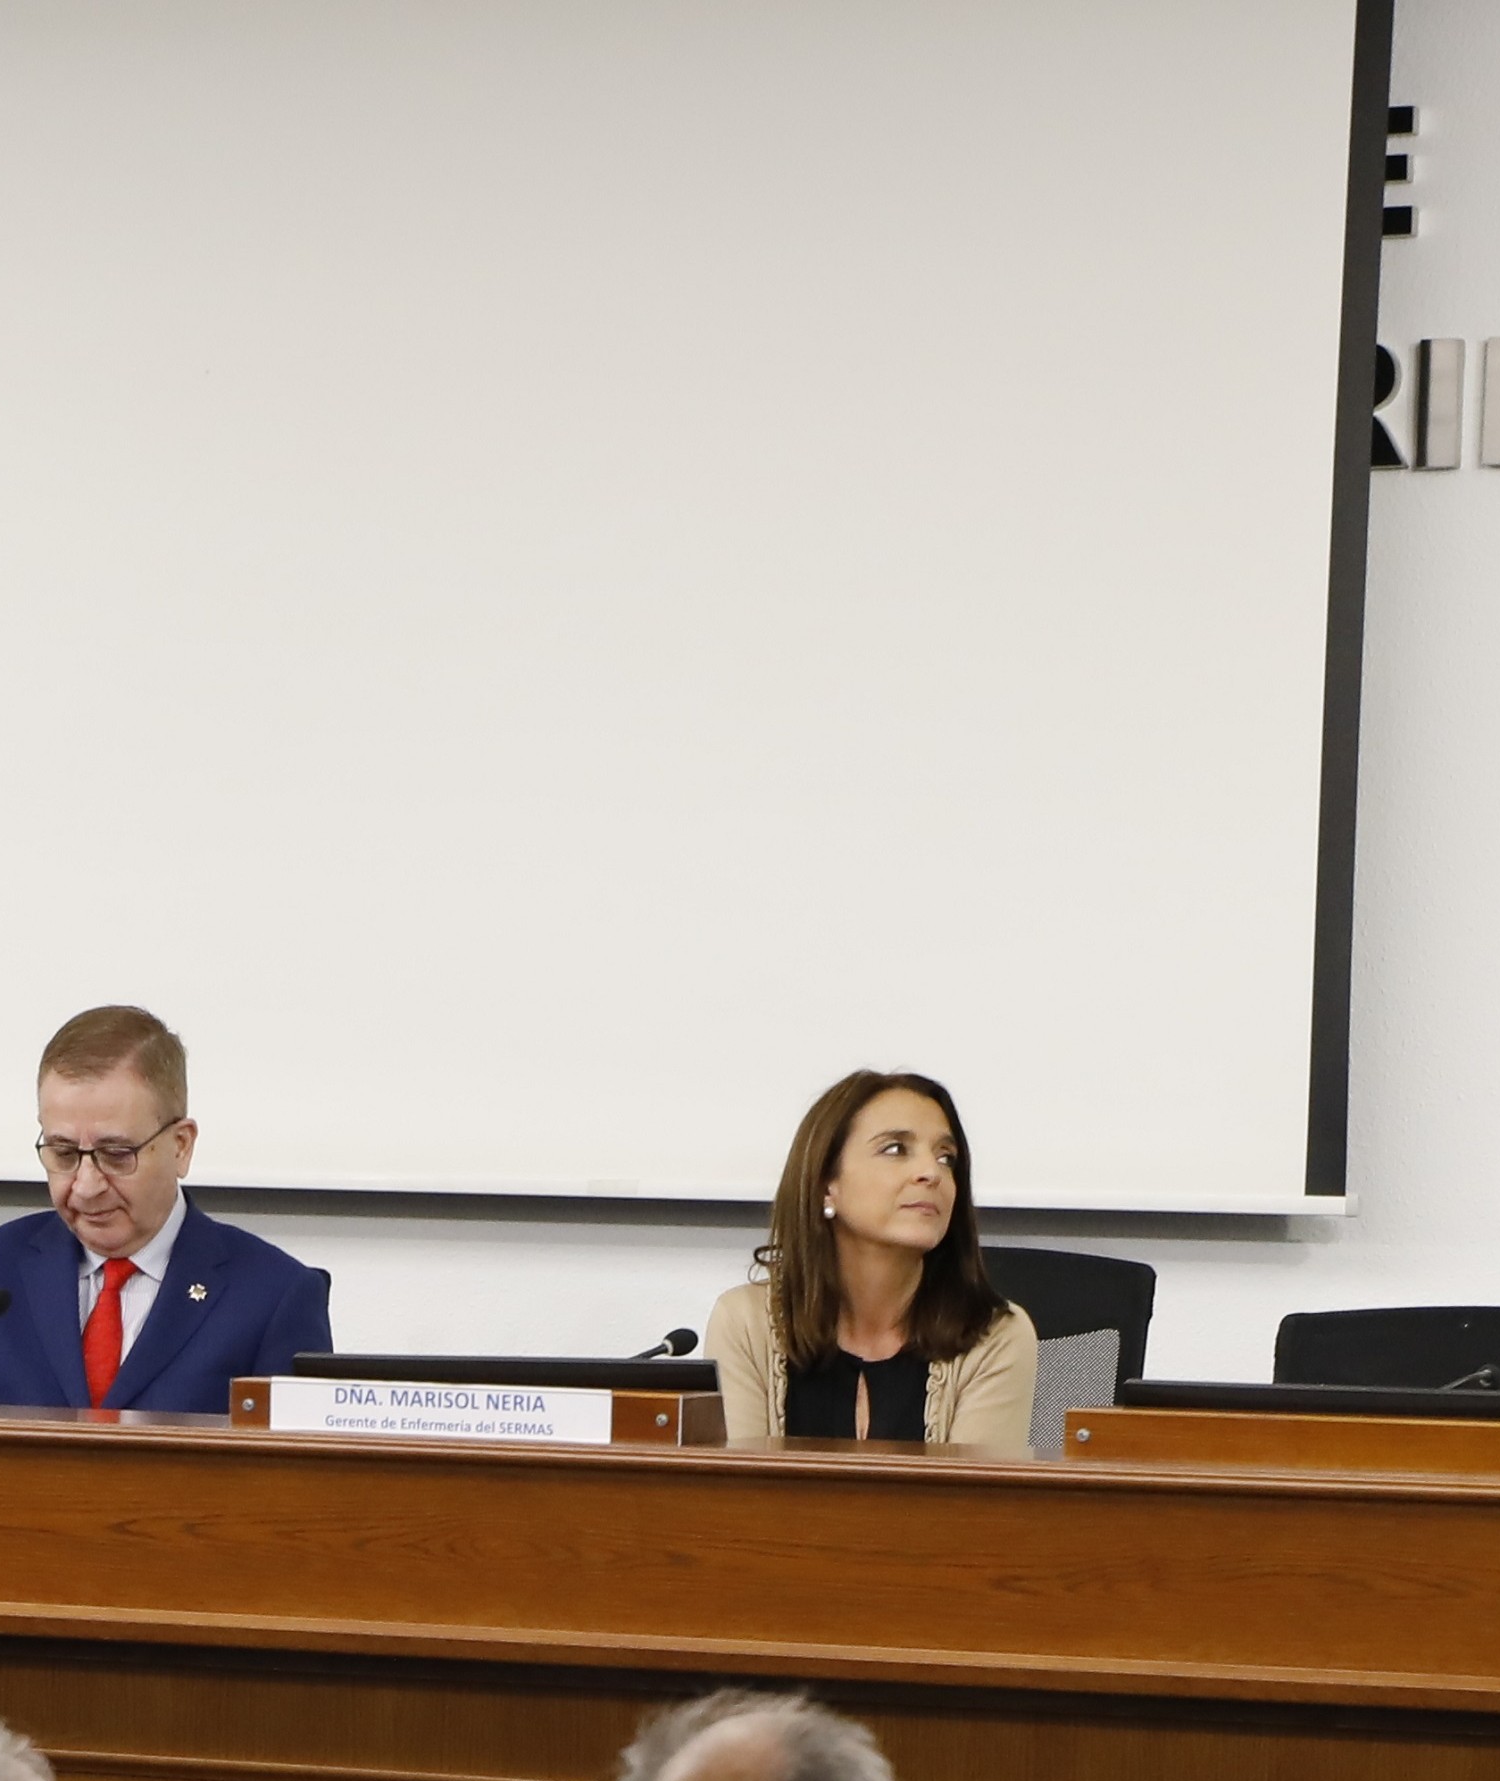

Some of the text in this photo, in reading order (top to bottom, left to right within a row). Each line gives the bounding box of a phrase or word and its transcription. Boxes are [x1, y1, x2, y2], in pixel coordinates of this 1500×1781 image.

[334, 1383, 546, 1413] DÑA. MARISOL NERIA
[325, 1414, 378, 1430] Gerente
[380, 1416, 397, 1430] de
[475, 1419, 497, 1434] del
[499, 1421, 554, 1437] SERMAS
